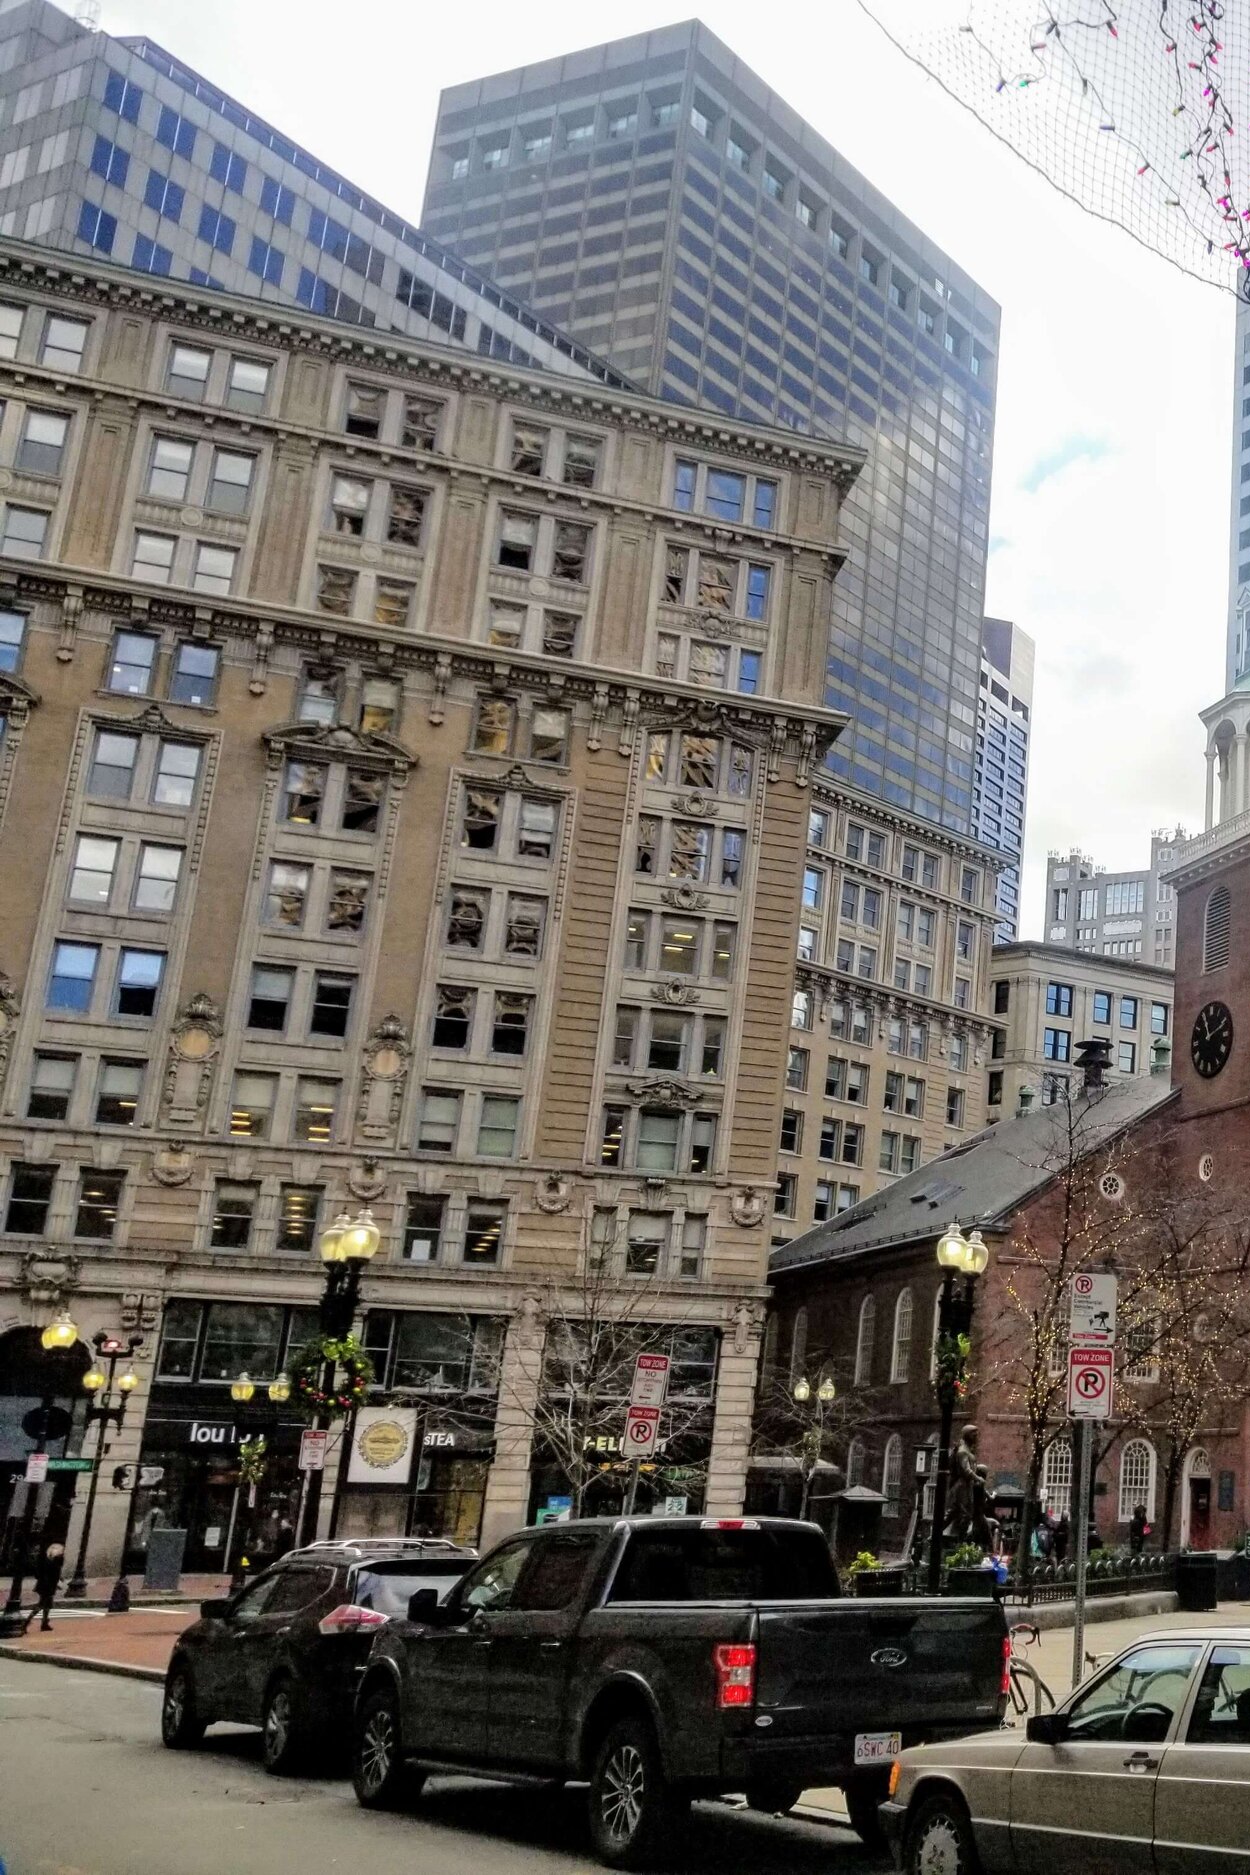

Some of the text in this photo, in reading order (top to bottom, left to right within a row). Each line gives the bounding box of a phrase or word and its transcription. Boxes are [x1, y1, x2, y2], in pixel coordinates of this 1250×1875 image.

[640, 1358, 667, 1369] TOW ZONE
[1074, 1353, 1110, 1362] TOW ZONE
[190, 1423, 225, 1443] lou
[857, 1740, 899, 1757] 6SWC 40
